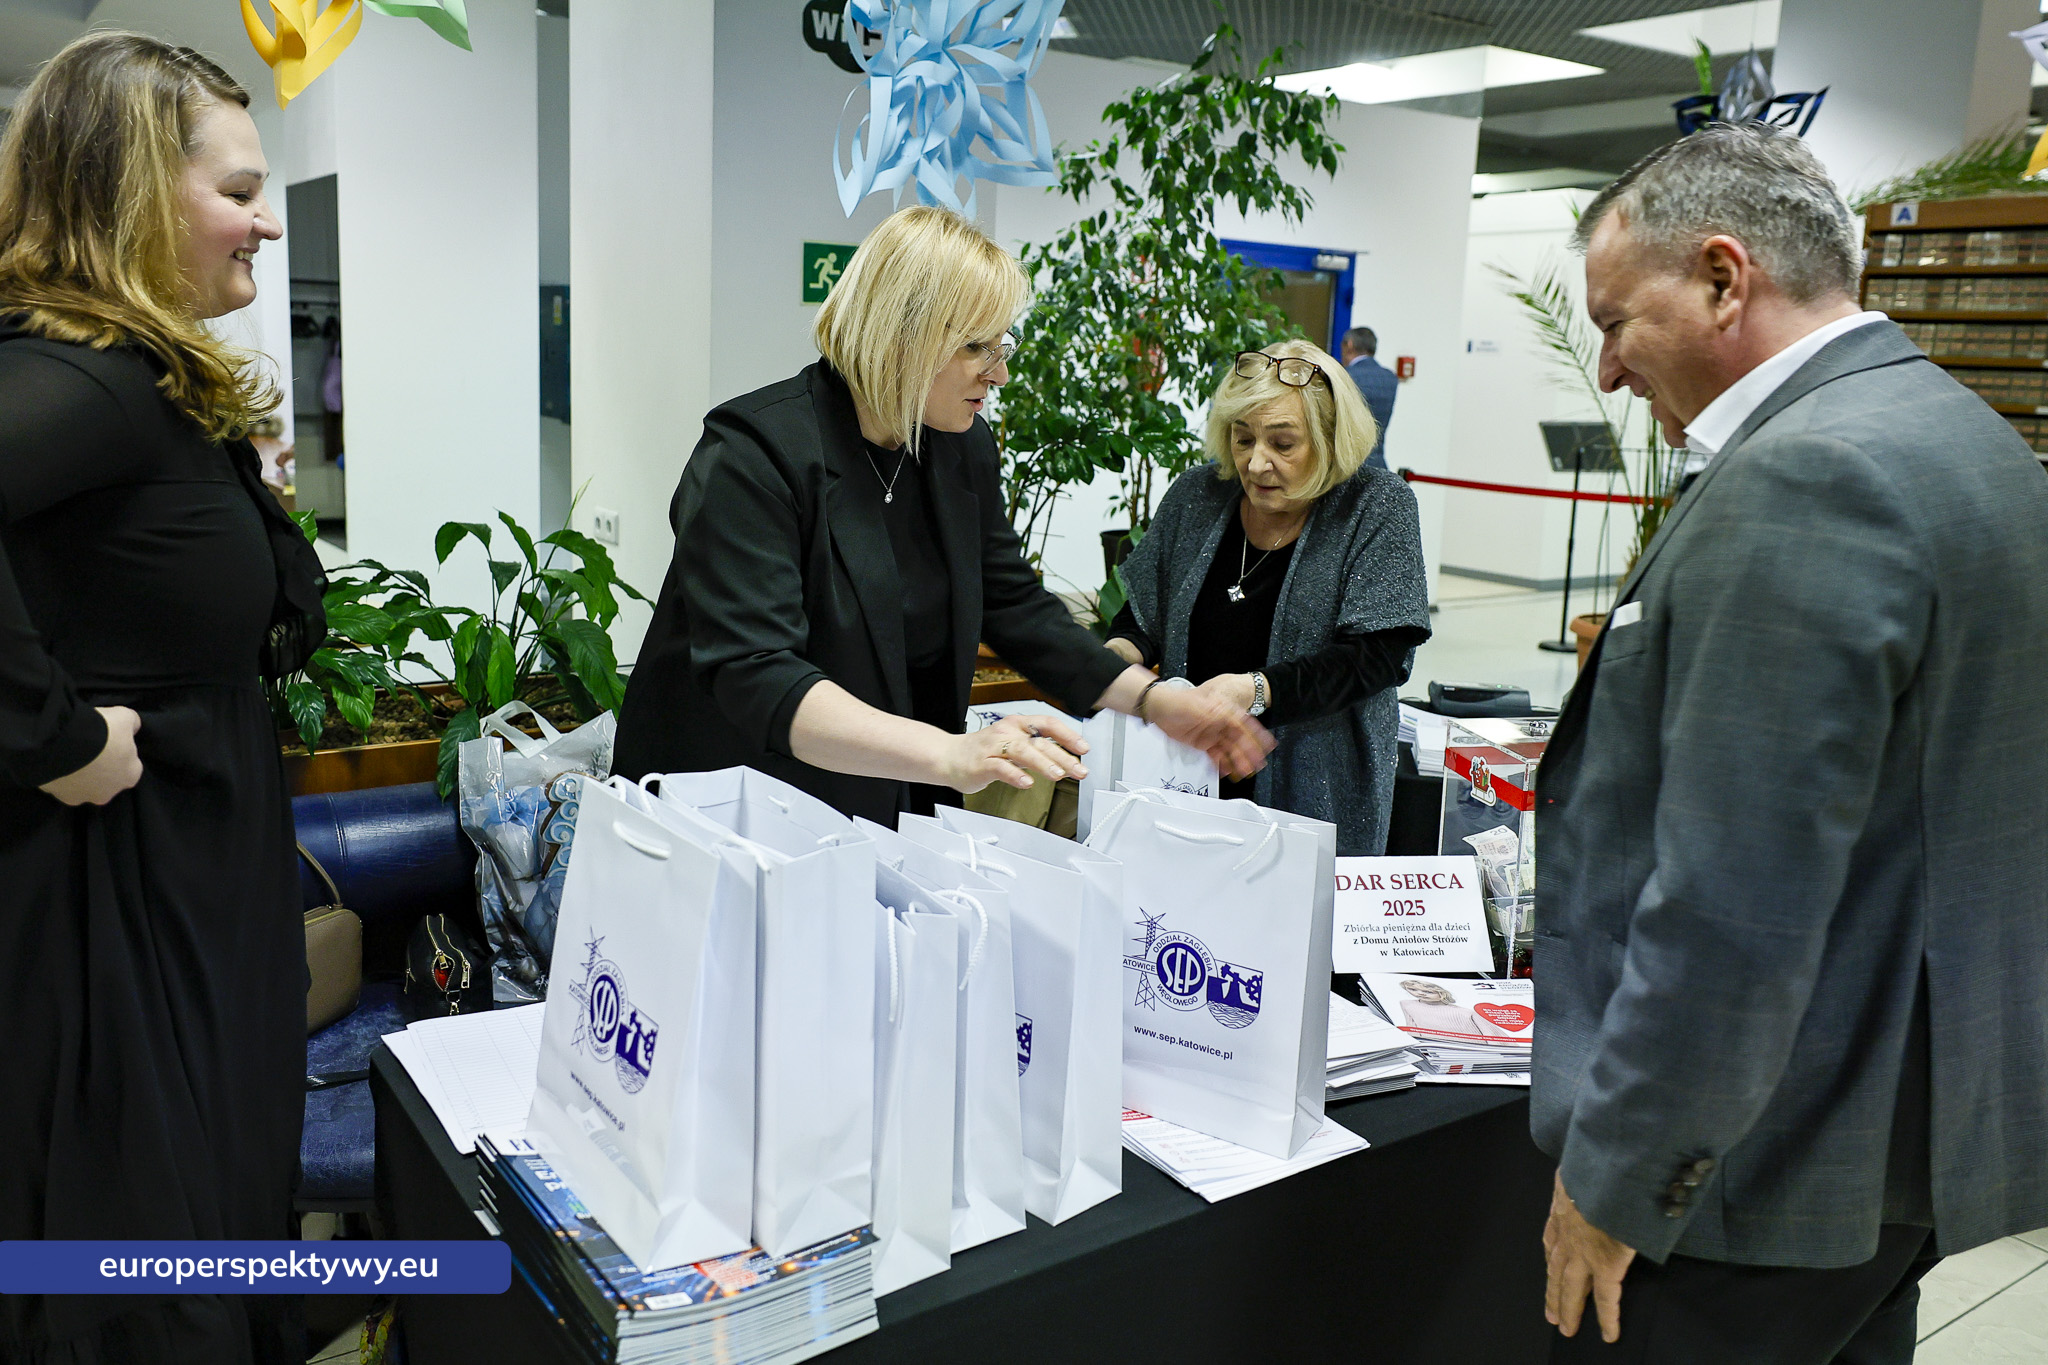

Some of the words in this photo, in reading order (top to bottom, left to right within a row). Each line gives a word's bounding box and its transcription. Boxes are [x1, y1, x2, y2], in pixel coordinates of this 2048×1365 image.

[1896, 206, 1912, 222] A
[1335, 875, 1385, 891] DAR
[1390, 873, 1464, 890] SERCA
[1382, 900, 1425, 916] 2025
[1344, 924, 1380, 933] Zbiórka
[1383, 923, 1426, 934] pieniężna
[1429, 923, 1442, 931] dla
[1445, 923, 1471, 931] dzieci
[1361, 936, 1389, 945] Domu
[1432, 935, 1469, 943] Stróżów
[1153, 934, 1182, 953] ODDZIAŁ
[1184, 935, 1213, 972] ZAGŁĘBIA
[1393, 948, 1445, 957] Katowicach
[1122, 958, 1156, 972] ATOWICE
[1161, 947, 1202, 994] SEP
[1157, 983, 1198, 1006] WĘGLOWEGO
[1134, 1025, 1233, 1061] www.sep.katowice.pl
